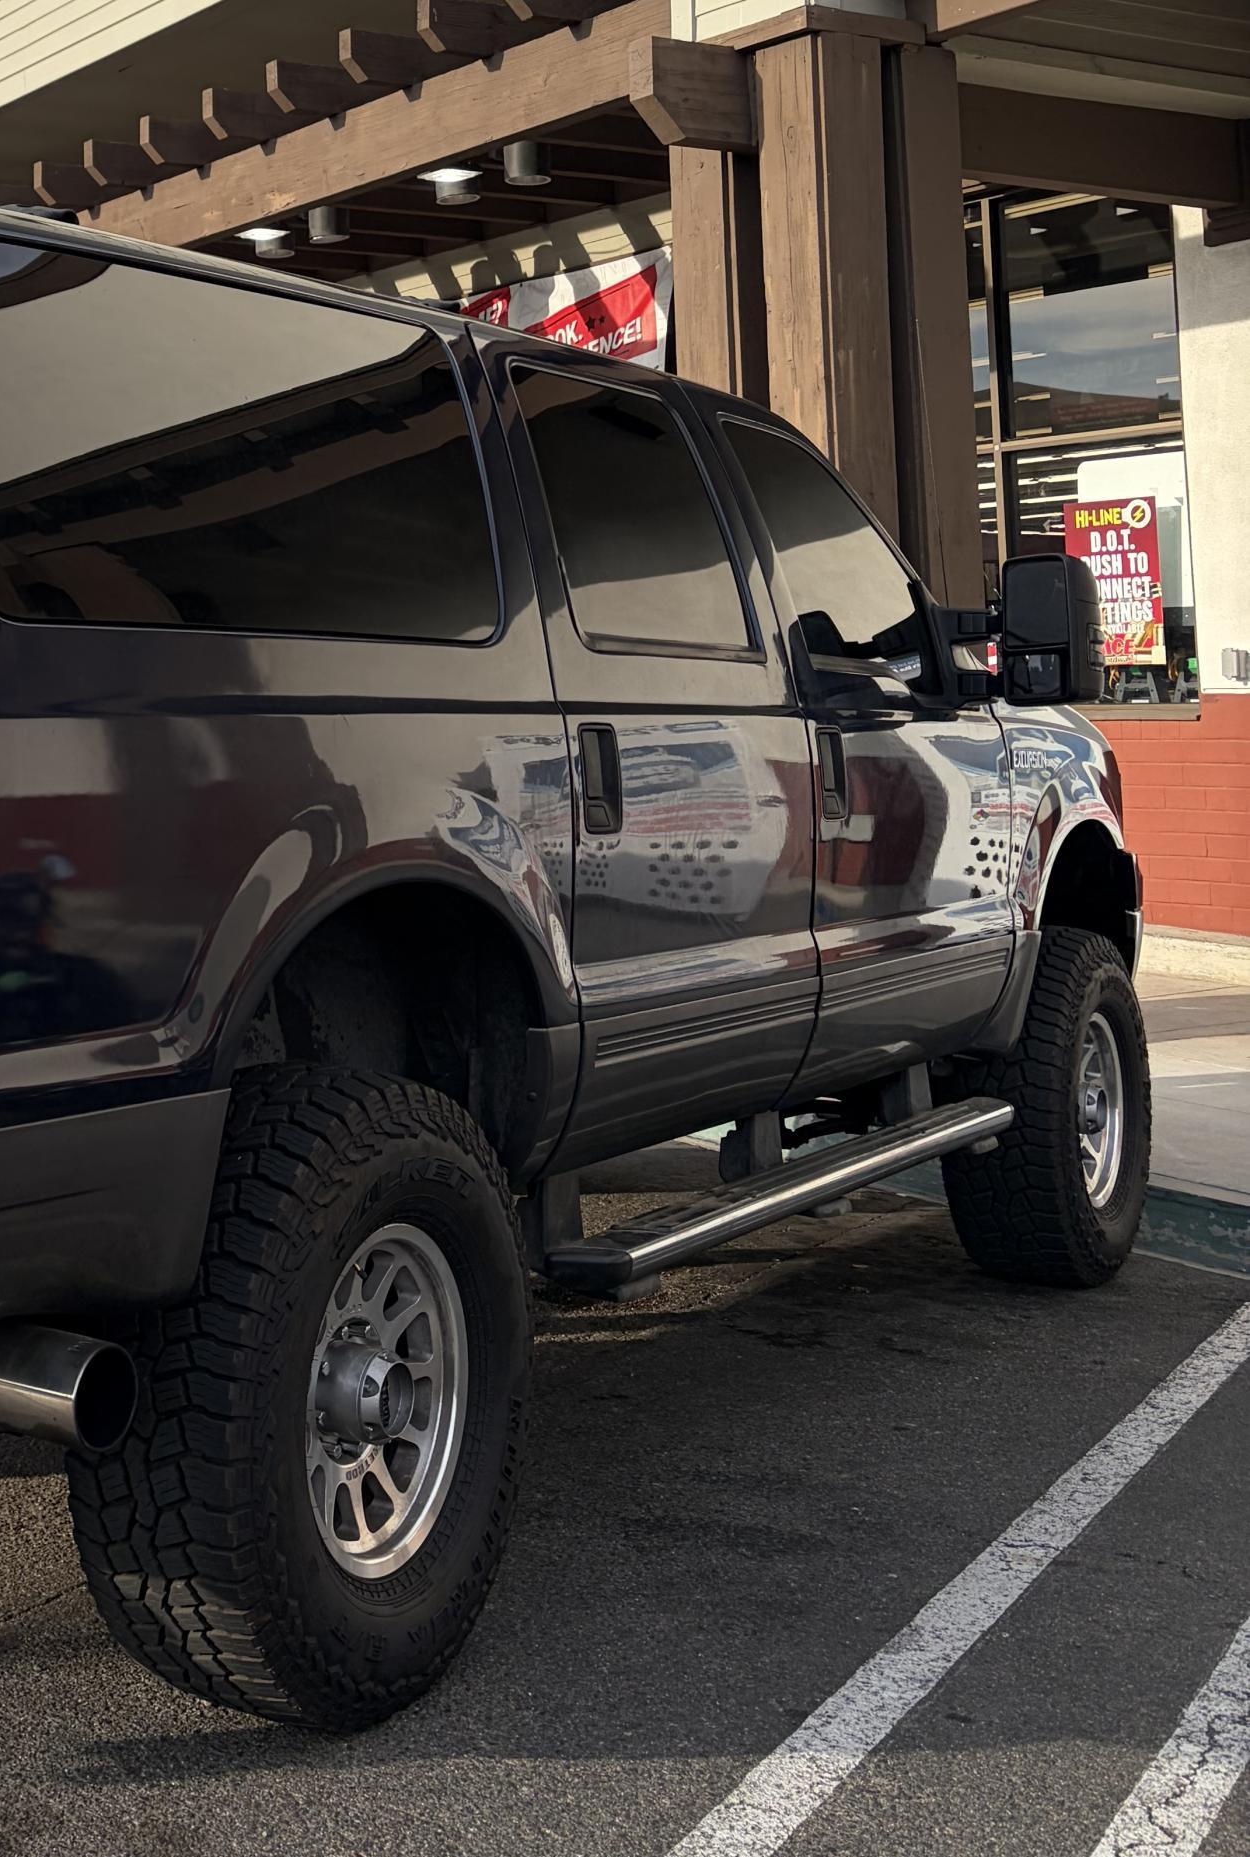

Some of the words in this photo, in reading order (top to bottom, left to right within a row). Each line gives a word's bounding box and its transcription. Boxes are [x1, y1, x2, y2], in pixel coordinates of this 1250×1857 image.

[545, 320, 584, 346] OK.
[582, 317, 642, 354] ENCE!
[1075, 507, 1122, 529] HI-LINE
[1090, 528, 1136, 553] D.O.T.
[1127, 551, 1149, 575] TO
[1096, 576, 1152, 600] NNECT
[1099, 600, 1153, 624] TINGS
[1102, 637, 1135, 656] ACE
